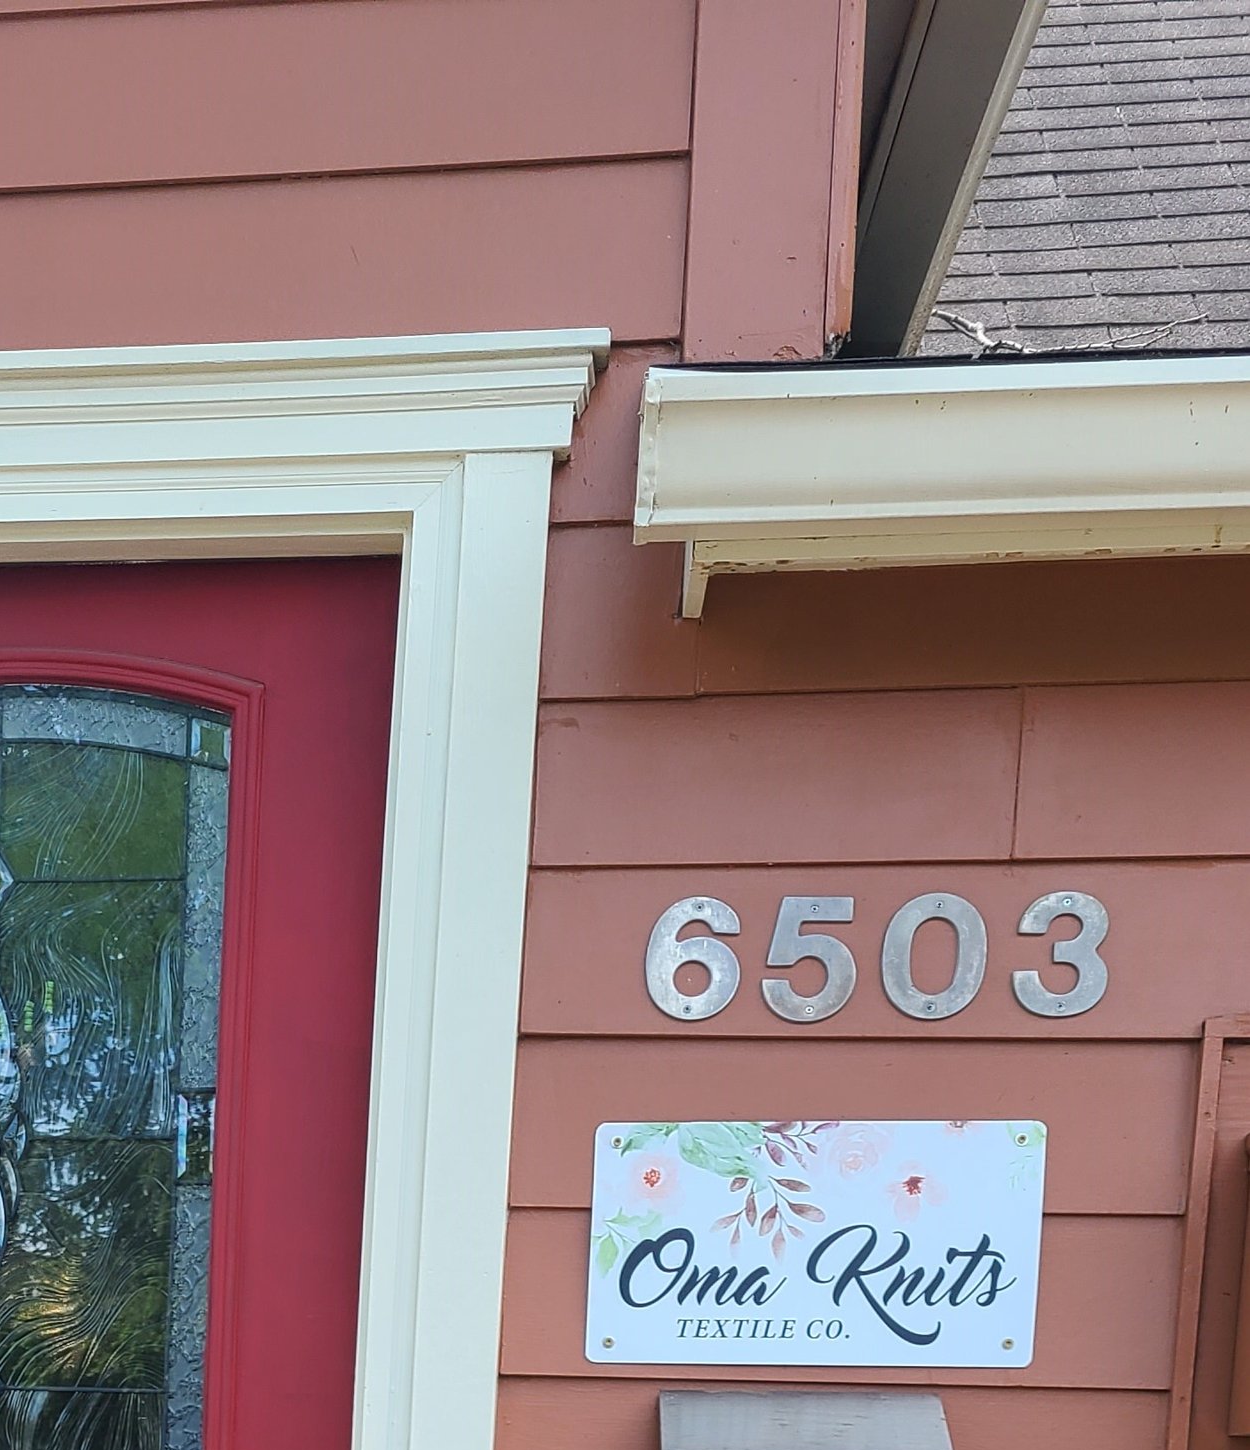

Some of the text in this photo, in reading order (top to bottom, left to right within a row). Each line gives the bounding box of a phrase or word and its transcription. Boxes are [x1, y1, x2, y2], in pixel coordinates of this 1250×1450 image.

[645, 891, 1110, 1024] 6503
[619, 1224, 1018, 1346] Oma Knits
[676, 1318, 851, 1340] TEXTILE CO.
